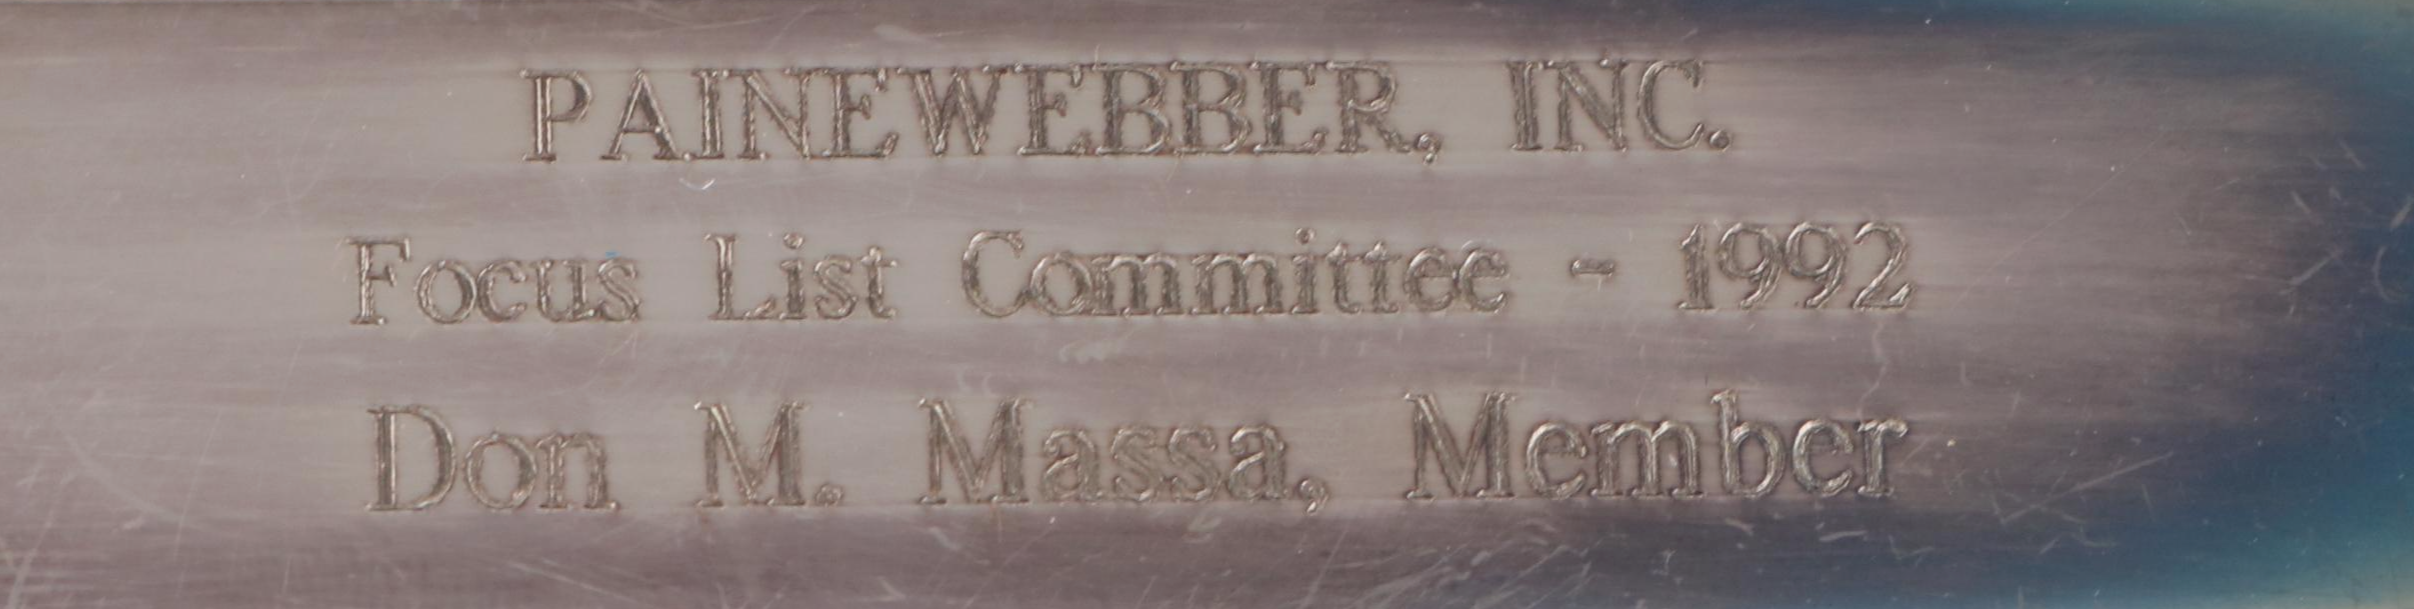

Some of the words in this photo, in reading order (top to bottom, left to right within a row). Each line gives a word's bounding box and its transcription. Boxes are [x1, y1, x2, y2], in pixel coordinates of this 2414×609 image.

[519, 59, 1443, 164] PAINEWEBBER,
[1505, 57, 1733, 154] INC.
[345, 236, 642, 325] Focus
[704, 232, 899, 322] List
[960, 225, 1511, 319] Committee
[1570, 258, 1617, 280] -
[1677, 221, 1915, 313] 1992
[366, 404, 621, 512] Don
[694, 397, 846, 508] M.
[917, 397, 1330, 515] Massa,
[1403, 388, 1910, 501] Member
